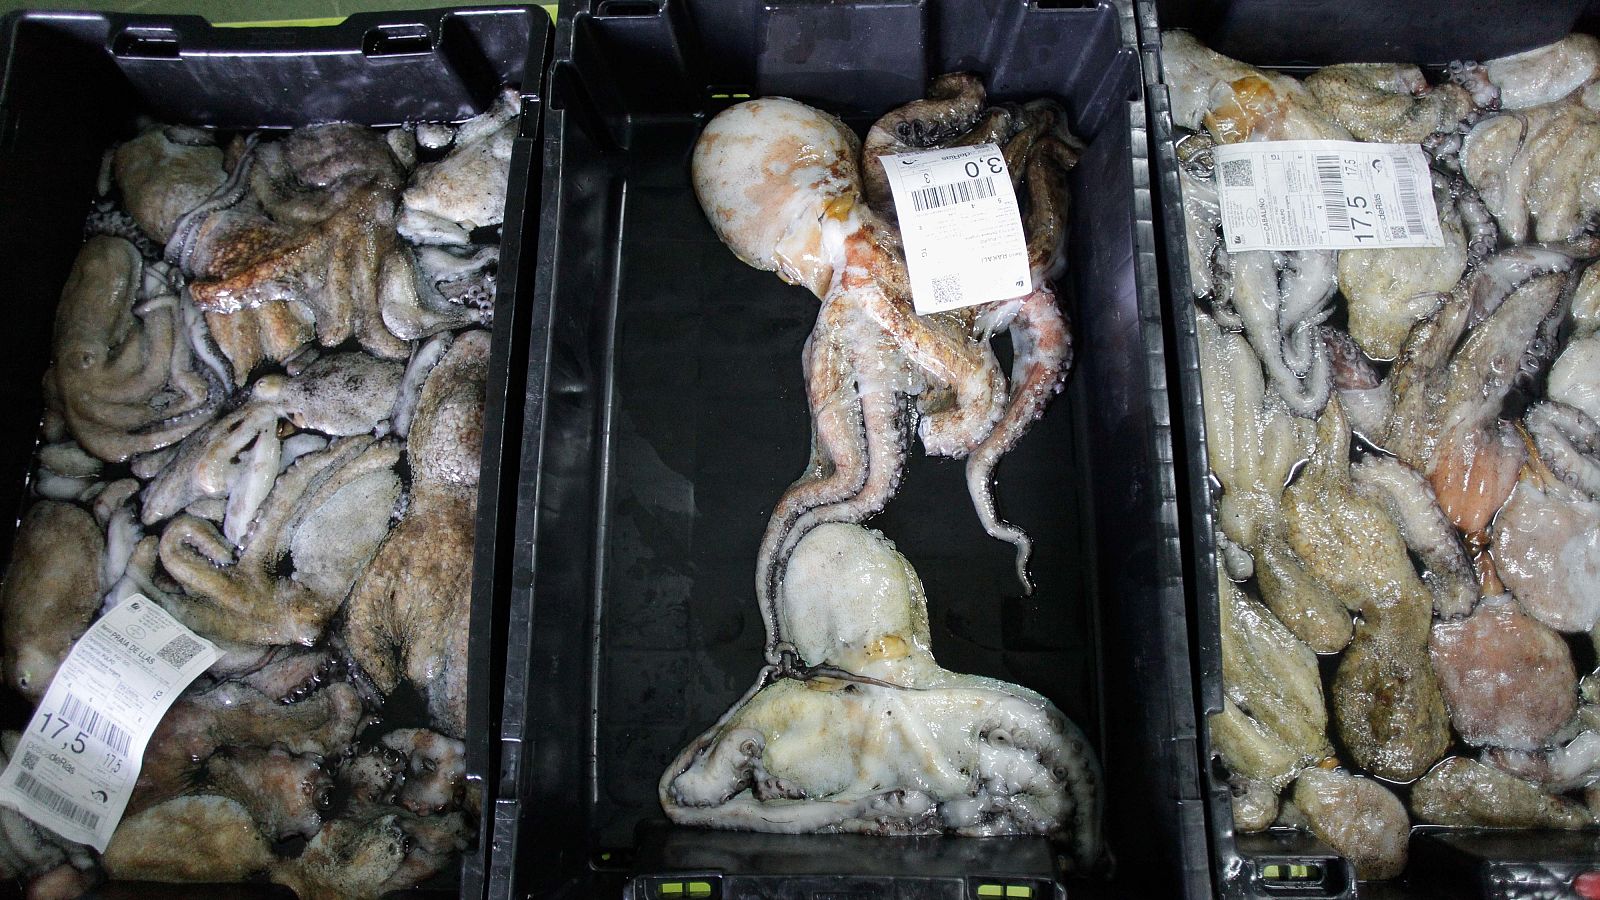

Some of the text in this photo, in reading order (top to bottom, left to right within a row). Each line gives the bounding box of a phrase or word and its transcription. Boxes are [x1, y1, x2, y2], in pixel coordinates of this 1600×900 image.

[922, 172, 931, 184] 3
[963, 155, 1003, 179] 3,0
[1346, 194, 1374, 242] 17,5
[111, 632, 131, 647] PRAIA
[128, 644, 139, 655] DE
[138, 651, 155, 665] LLAS
[39, 712, 88, 755] 17,5
